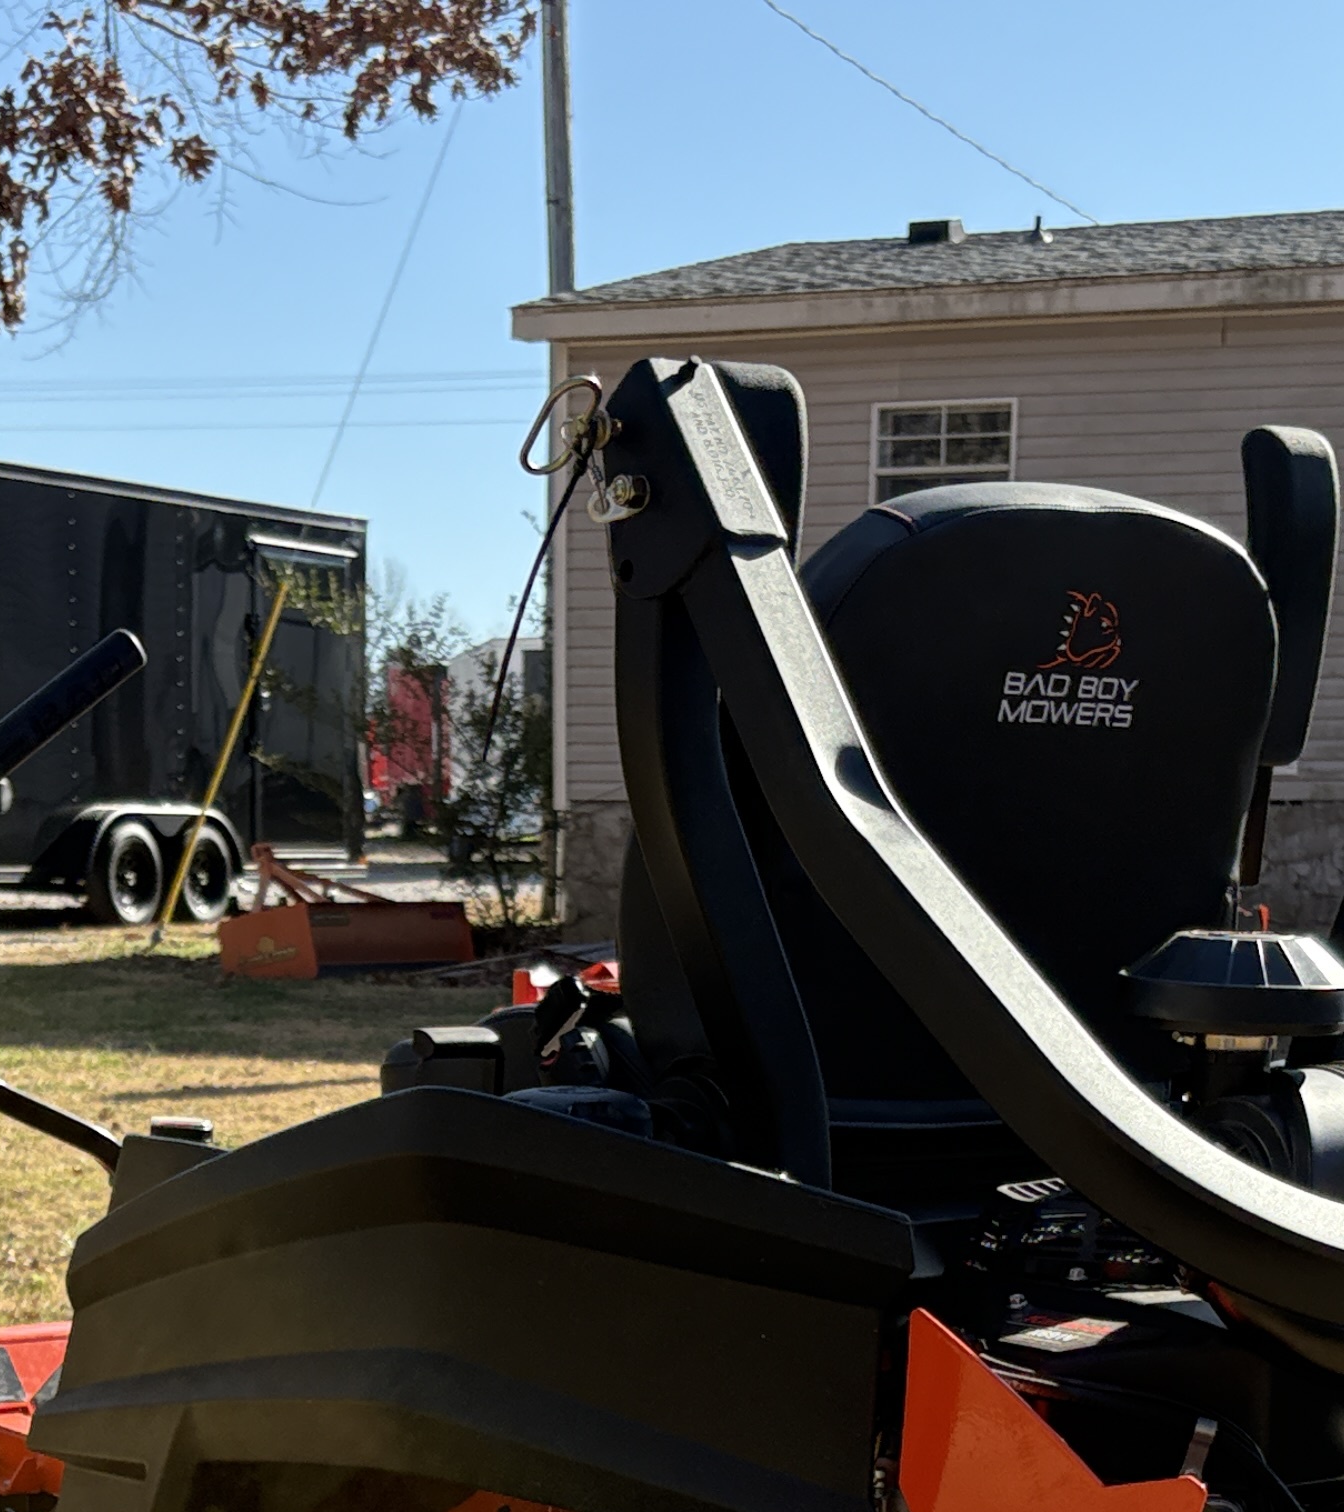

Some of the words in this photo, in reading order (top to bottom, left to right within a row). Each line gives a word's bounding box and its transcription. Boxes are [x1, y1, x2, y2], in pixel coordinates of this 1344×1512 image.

[1002, 670, 1072, 698] BAD
[1076, 675, 1140, 702] BOY
[995, 699, 1134, 729] MOWERS
